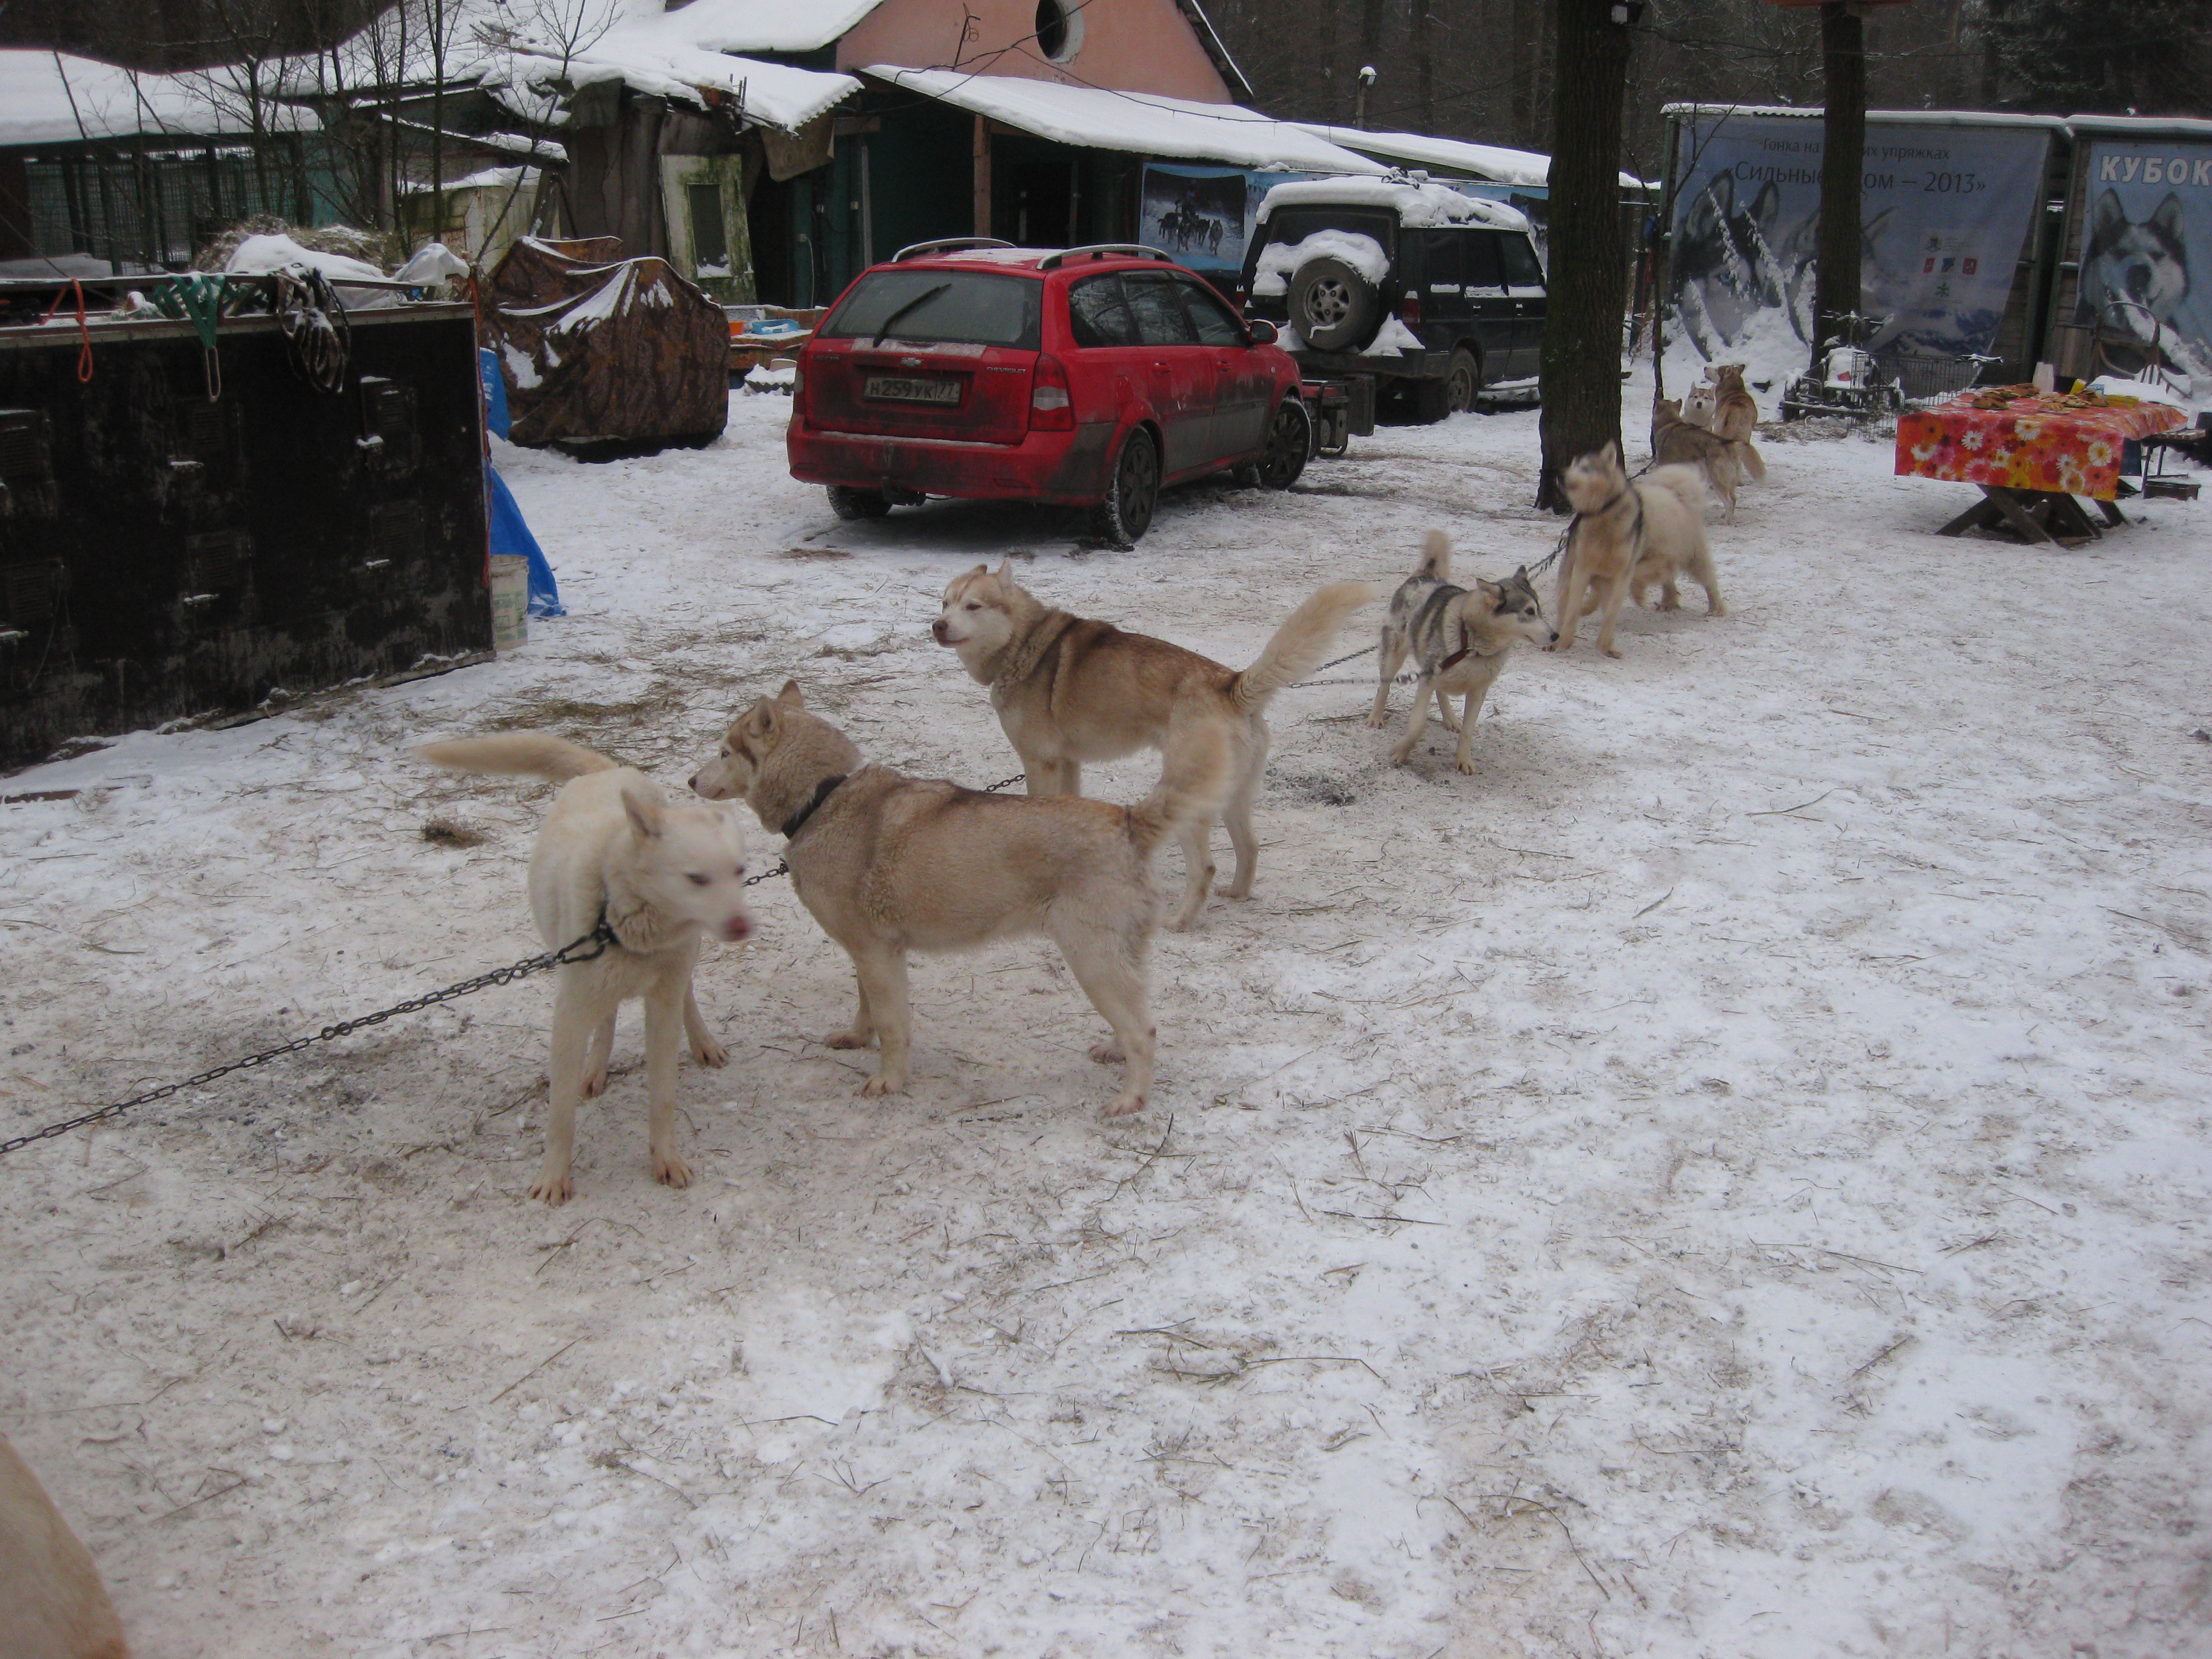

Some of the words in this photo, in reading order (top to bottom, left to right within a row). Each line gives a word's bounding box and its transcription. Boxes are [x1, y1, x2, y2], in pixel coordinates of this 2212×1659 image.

[1763, 138, 1800, 152] Гонка
[1804, 142, 1820, 153] на
[1882, 147, 1949, 162] упряжках
[1923, 172, 1986, 193] 2013»
[2099, 155, 2212, 187] КУБОК
